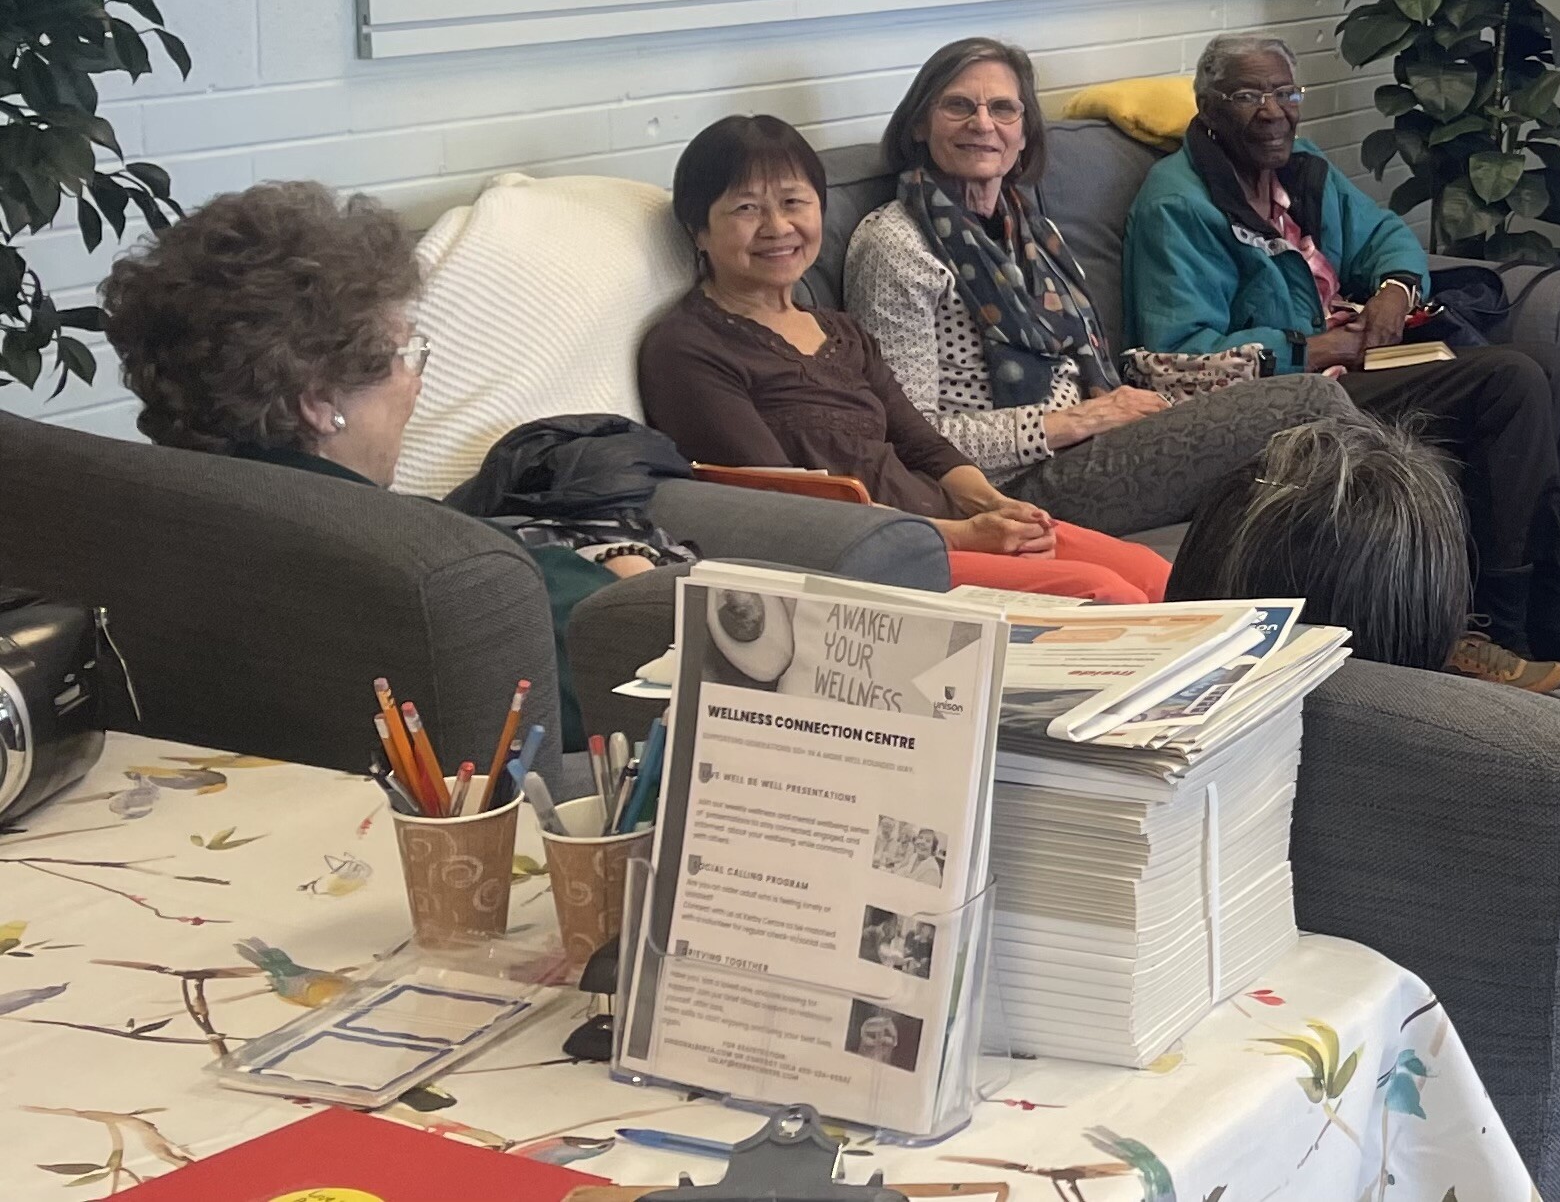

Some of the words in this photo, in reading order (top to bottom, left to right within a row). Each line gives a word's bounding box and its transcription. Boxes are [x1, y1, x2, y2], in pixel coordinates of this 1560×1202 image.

[827, 603, 904, 645] AWAKEN
[824, 631, 874, 679] YOUR
[814, 666, 903, 713] WELLNESS
[707, 704, 773, 726] WELLNESS
[775, 716, 862, 741] CONNECTION
[865, 731, 915, 750] CENTRE
[723, 772, 745, 784] WELL
[747, 777, 758, 787] BE
[761, 780, 782, 791] WELL
[786, 783, 857, 804] PRESENTATIONS
[727, 867, 763, 882] CALLING
[766, 875, 809, 890] PROGRAM
[725, 956, 769, 972] TOGETHER
